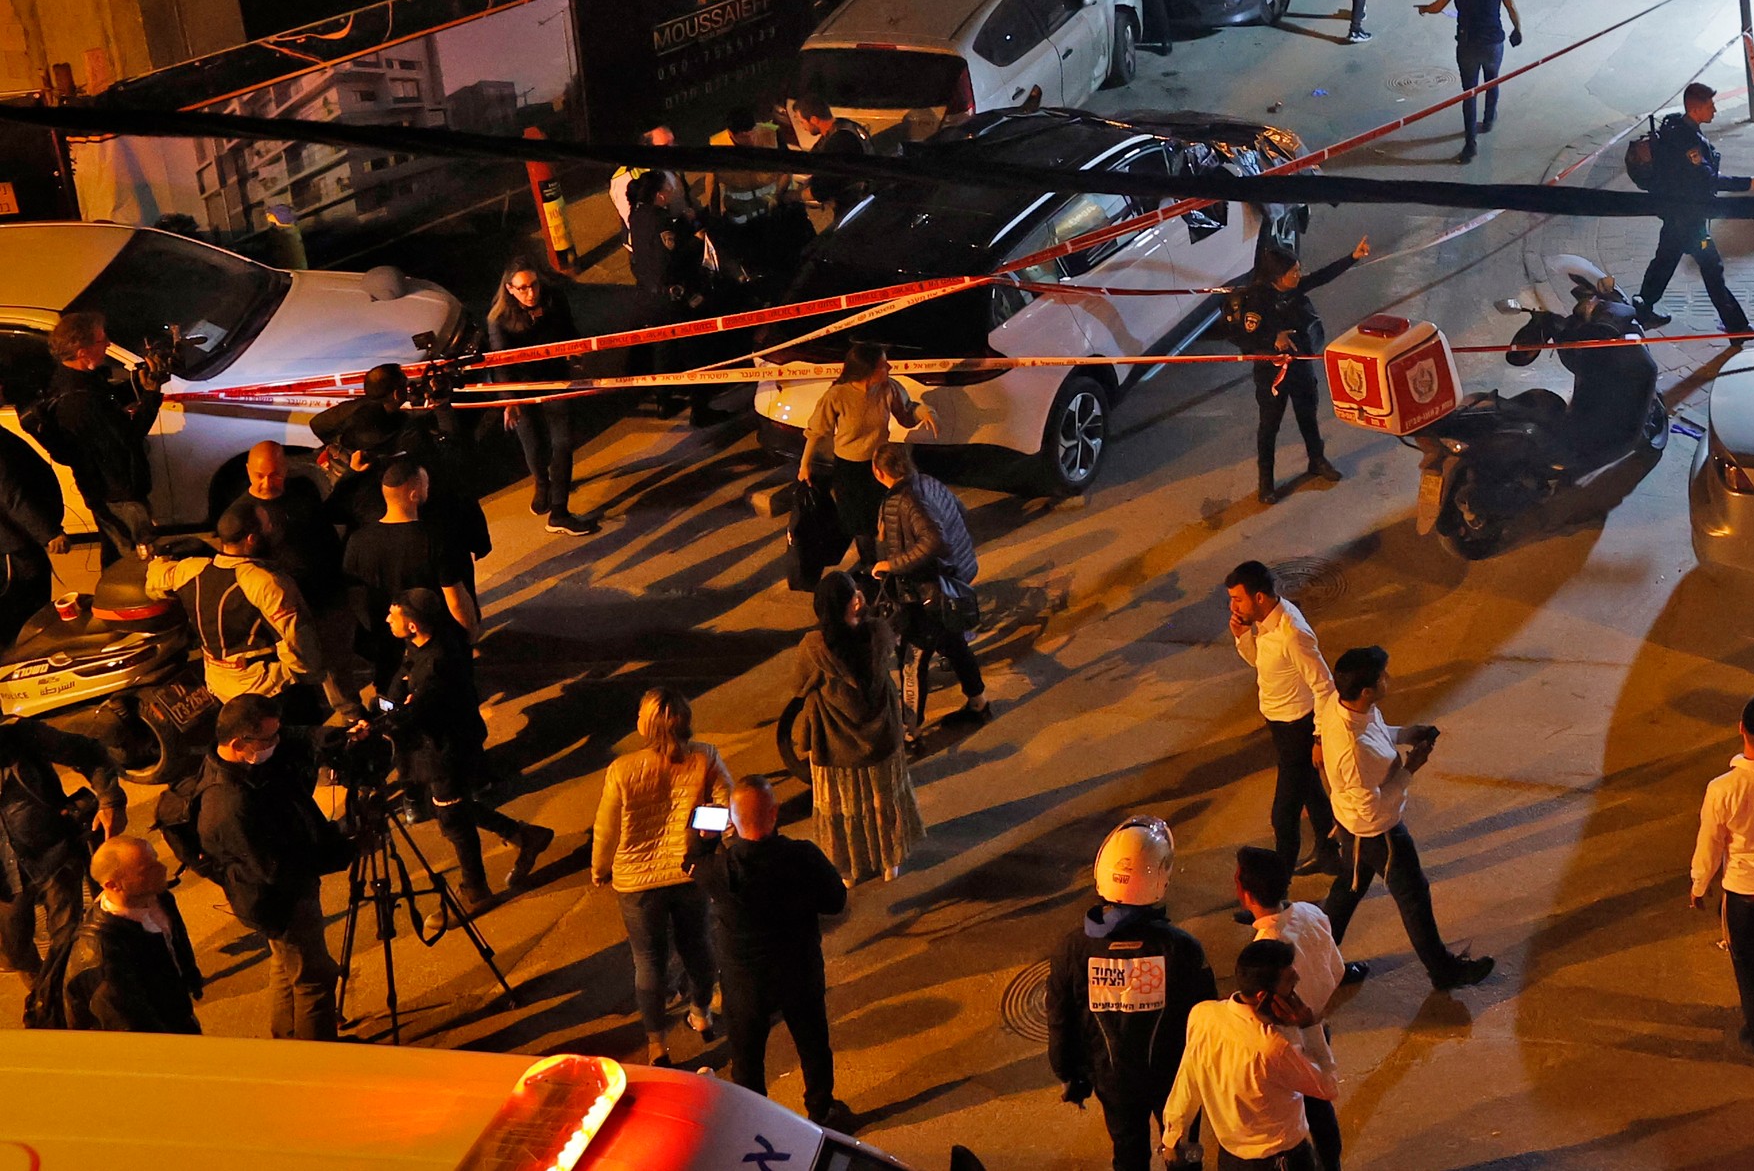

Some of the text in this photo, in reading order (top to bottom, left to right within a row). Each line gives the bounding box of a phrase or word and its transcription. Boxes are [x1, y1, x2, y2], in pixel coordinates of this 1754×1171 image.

[700, 372, 729, 381] משטרת
[739, 370, 760, 379] מעבר
[761, 370, 774, 379] אין
[786, 368, 811, 377] ישראל
[12, 663, 49, 679] משטרה
[1092, 966, 1125, 978] איחוד
[1092, 977, 1125, 987] הצלה
